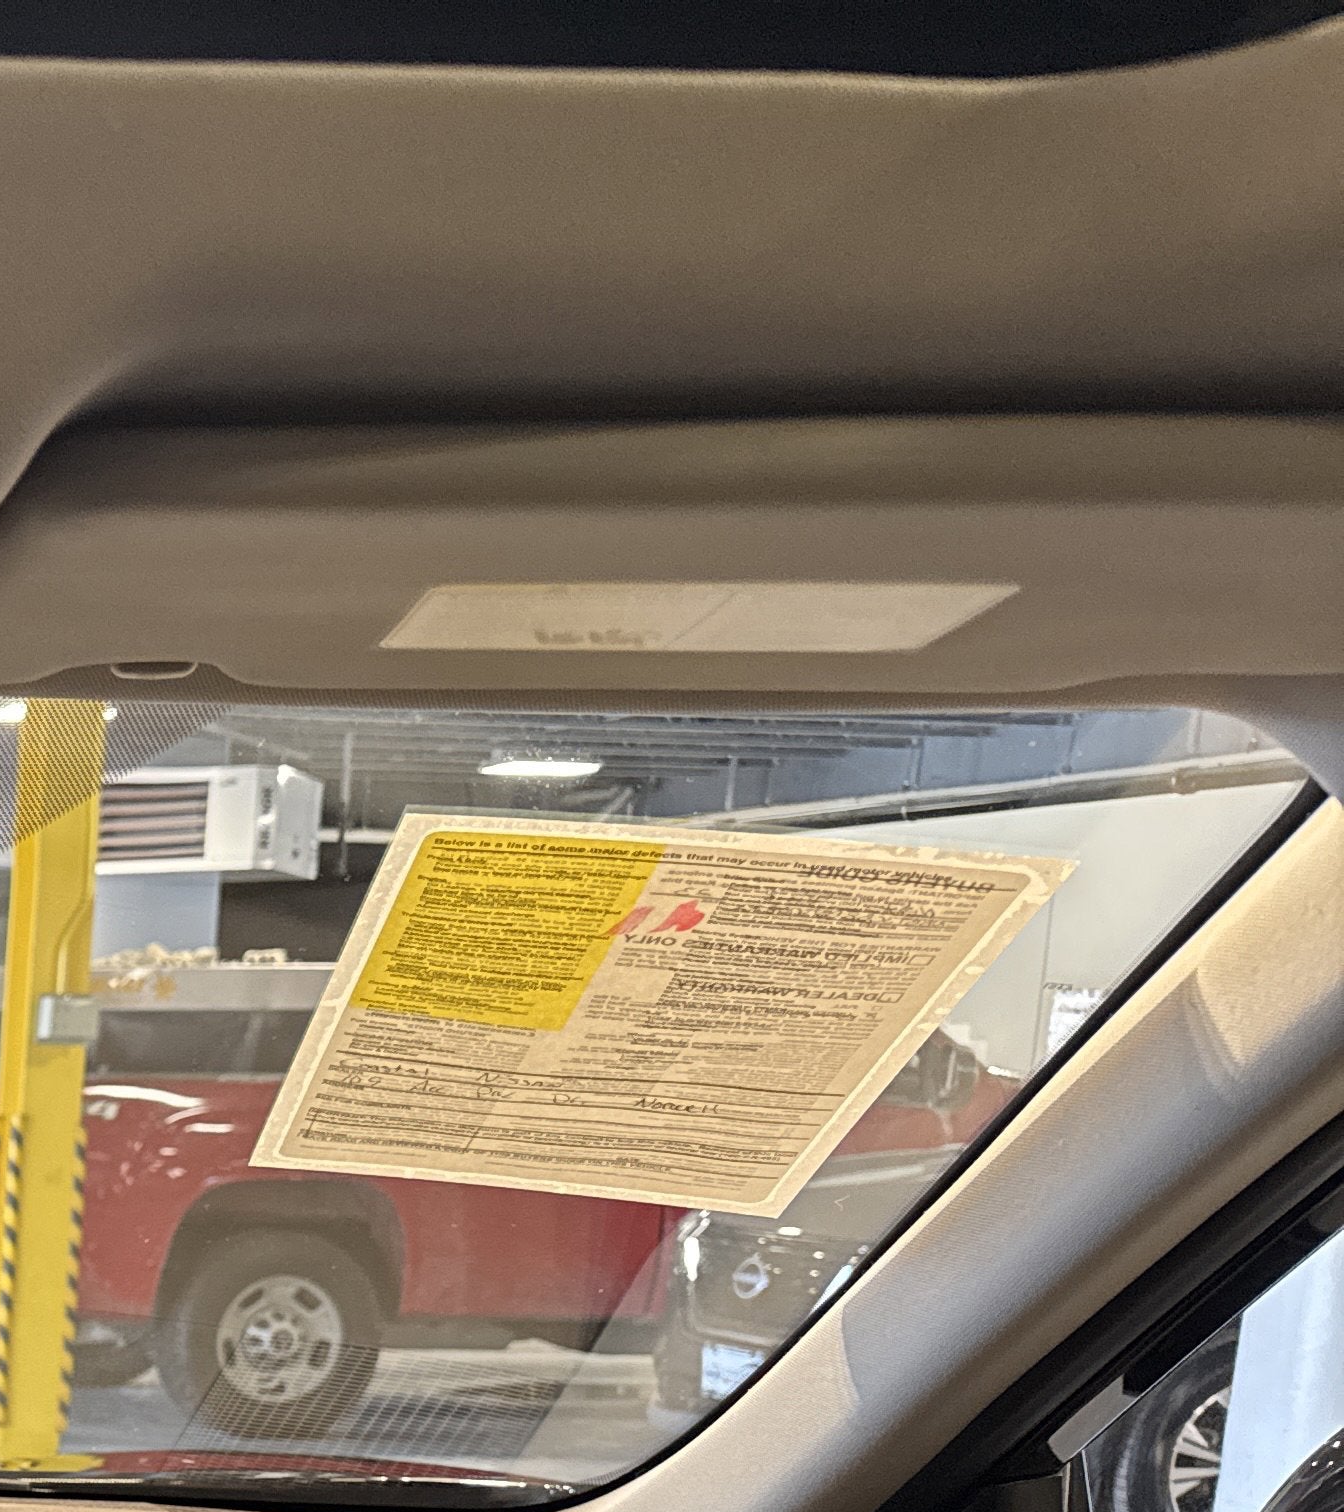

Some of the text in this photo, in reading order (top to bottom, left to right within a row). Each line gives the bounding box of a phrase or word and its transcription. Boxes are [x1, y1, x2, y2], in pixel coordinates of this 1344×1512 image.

[433, 838, 476, 848] Below
[506, 842, 528, 850] list
[530, 843, 547, 852] of
[631, 849, 683, 859] defects
[686, 852, 715, 862] that
[716, 857, 748, 867] may
[753, 859, 791, 869] occur
